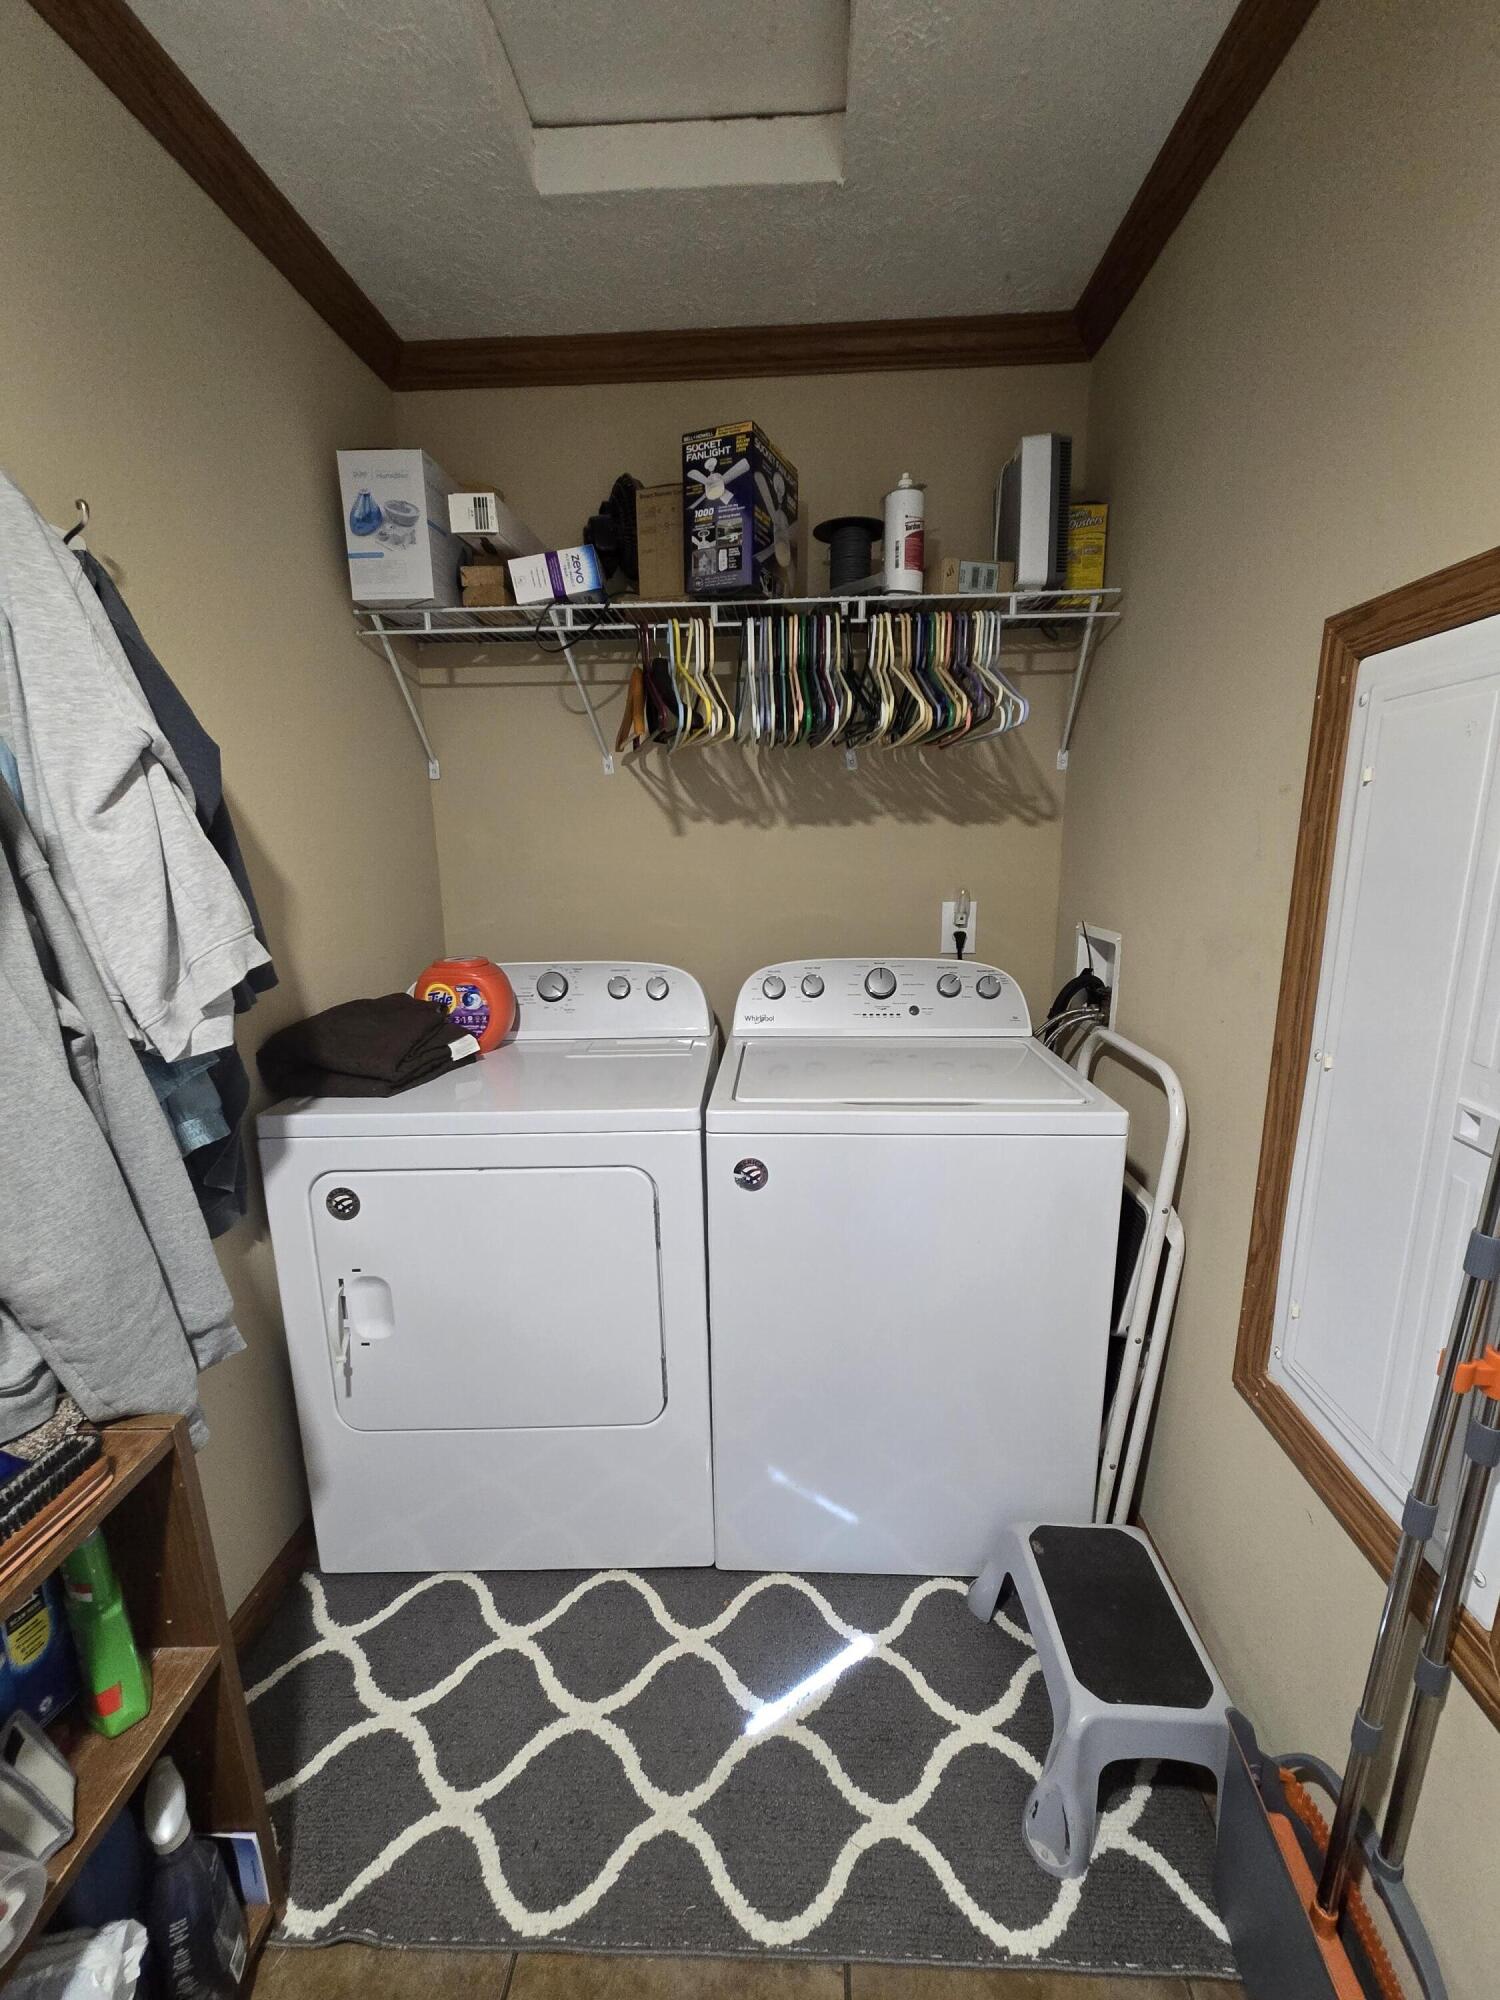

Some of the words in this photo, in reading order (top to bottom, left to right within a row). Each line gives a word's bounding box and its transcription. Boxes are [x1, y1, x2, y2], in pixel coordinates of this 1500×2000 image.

[686, 439, 722, 453] SOCKET
[686, 446, 731, 462] FANLIGHT
[694, 507, 714, 518] 1000
[428, 991, 453, 1005] Tide
[744, 1014, 775, 1024] Whirlpool
